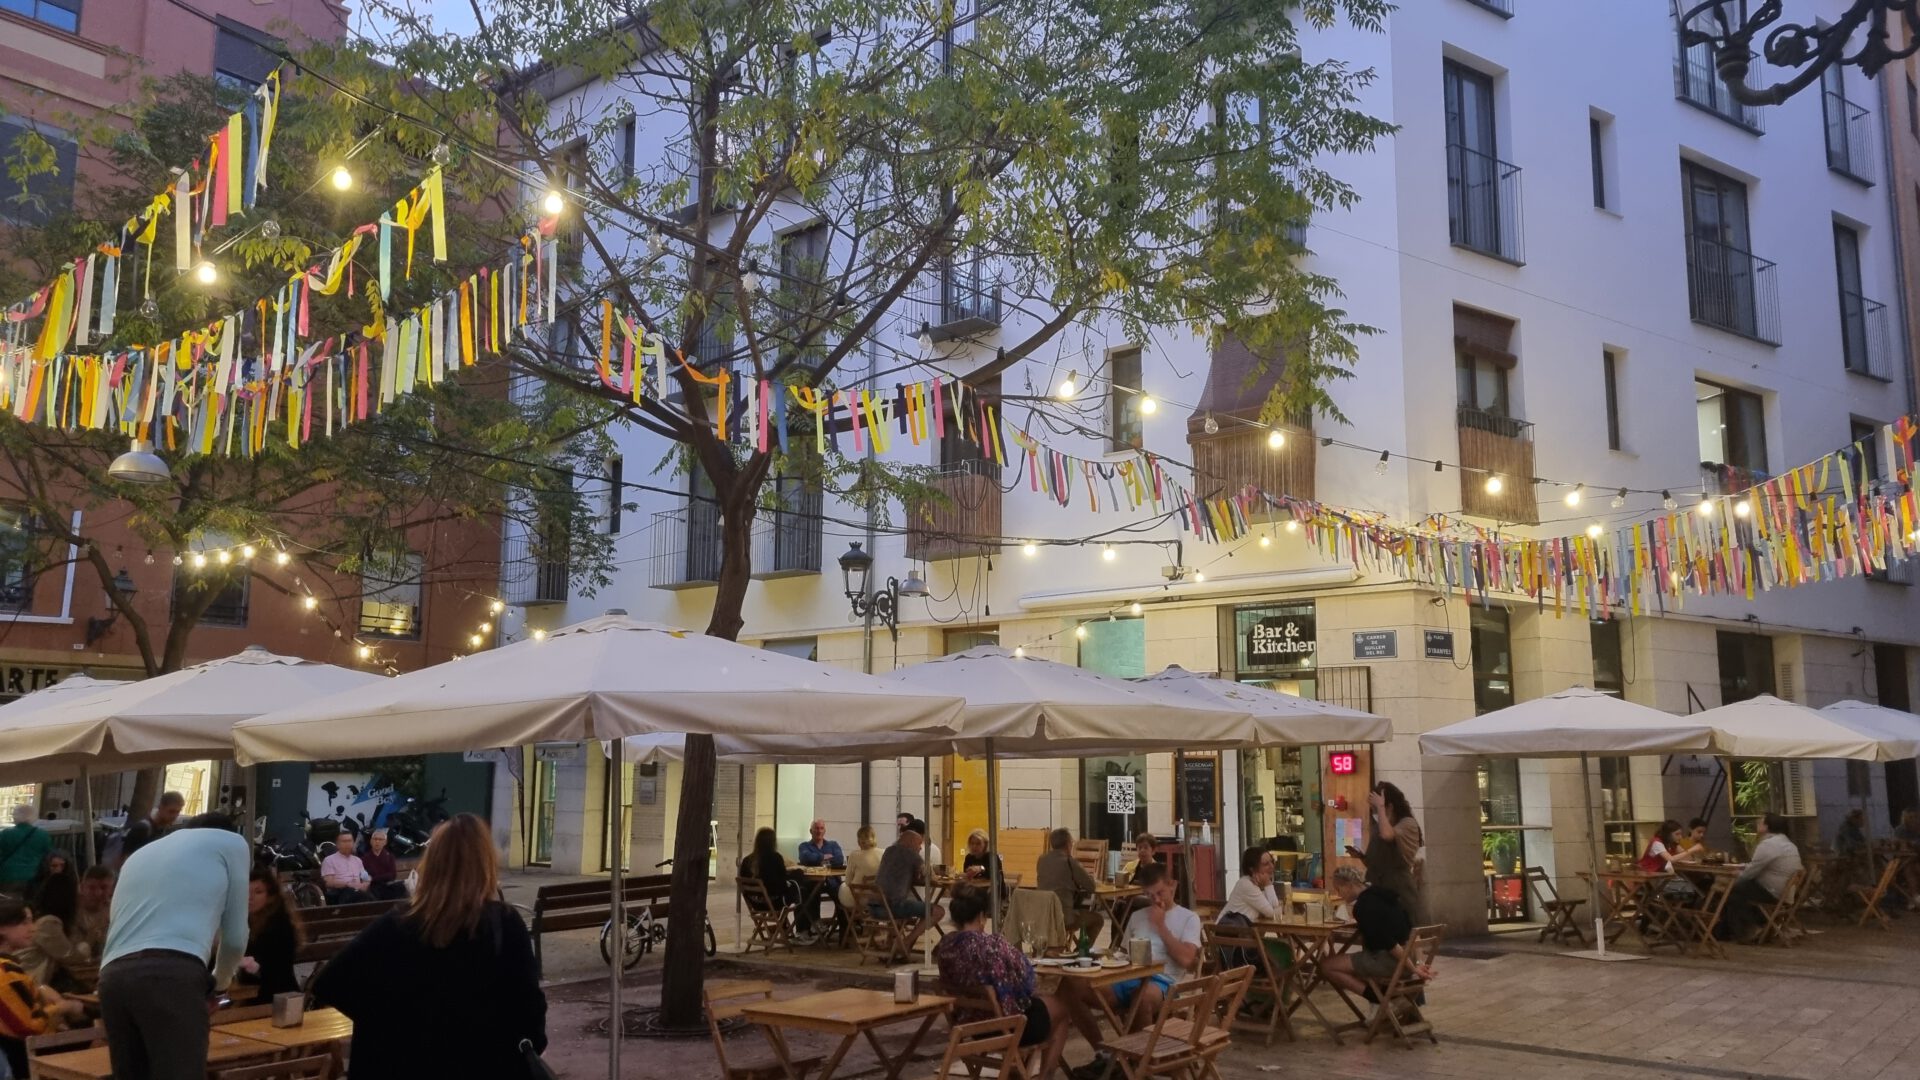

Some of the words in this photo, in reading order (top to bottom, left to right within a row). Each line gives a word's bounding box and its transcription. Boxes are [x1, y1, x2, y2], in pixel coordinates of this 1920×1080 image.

[1253, 624, 1283, 639] Bar
[1285, 622, 1300, 637] &
[1253, 638, 1316, 654] Kitchen
[1333, 756, 1353, 771] 58
[367, 783, 394, 798] Good
